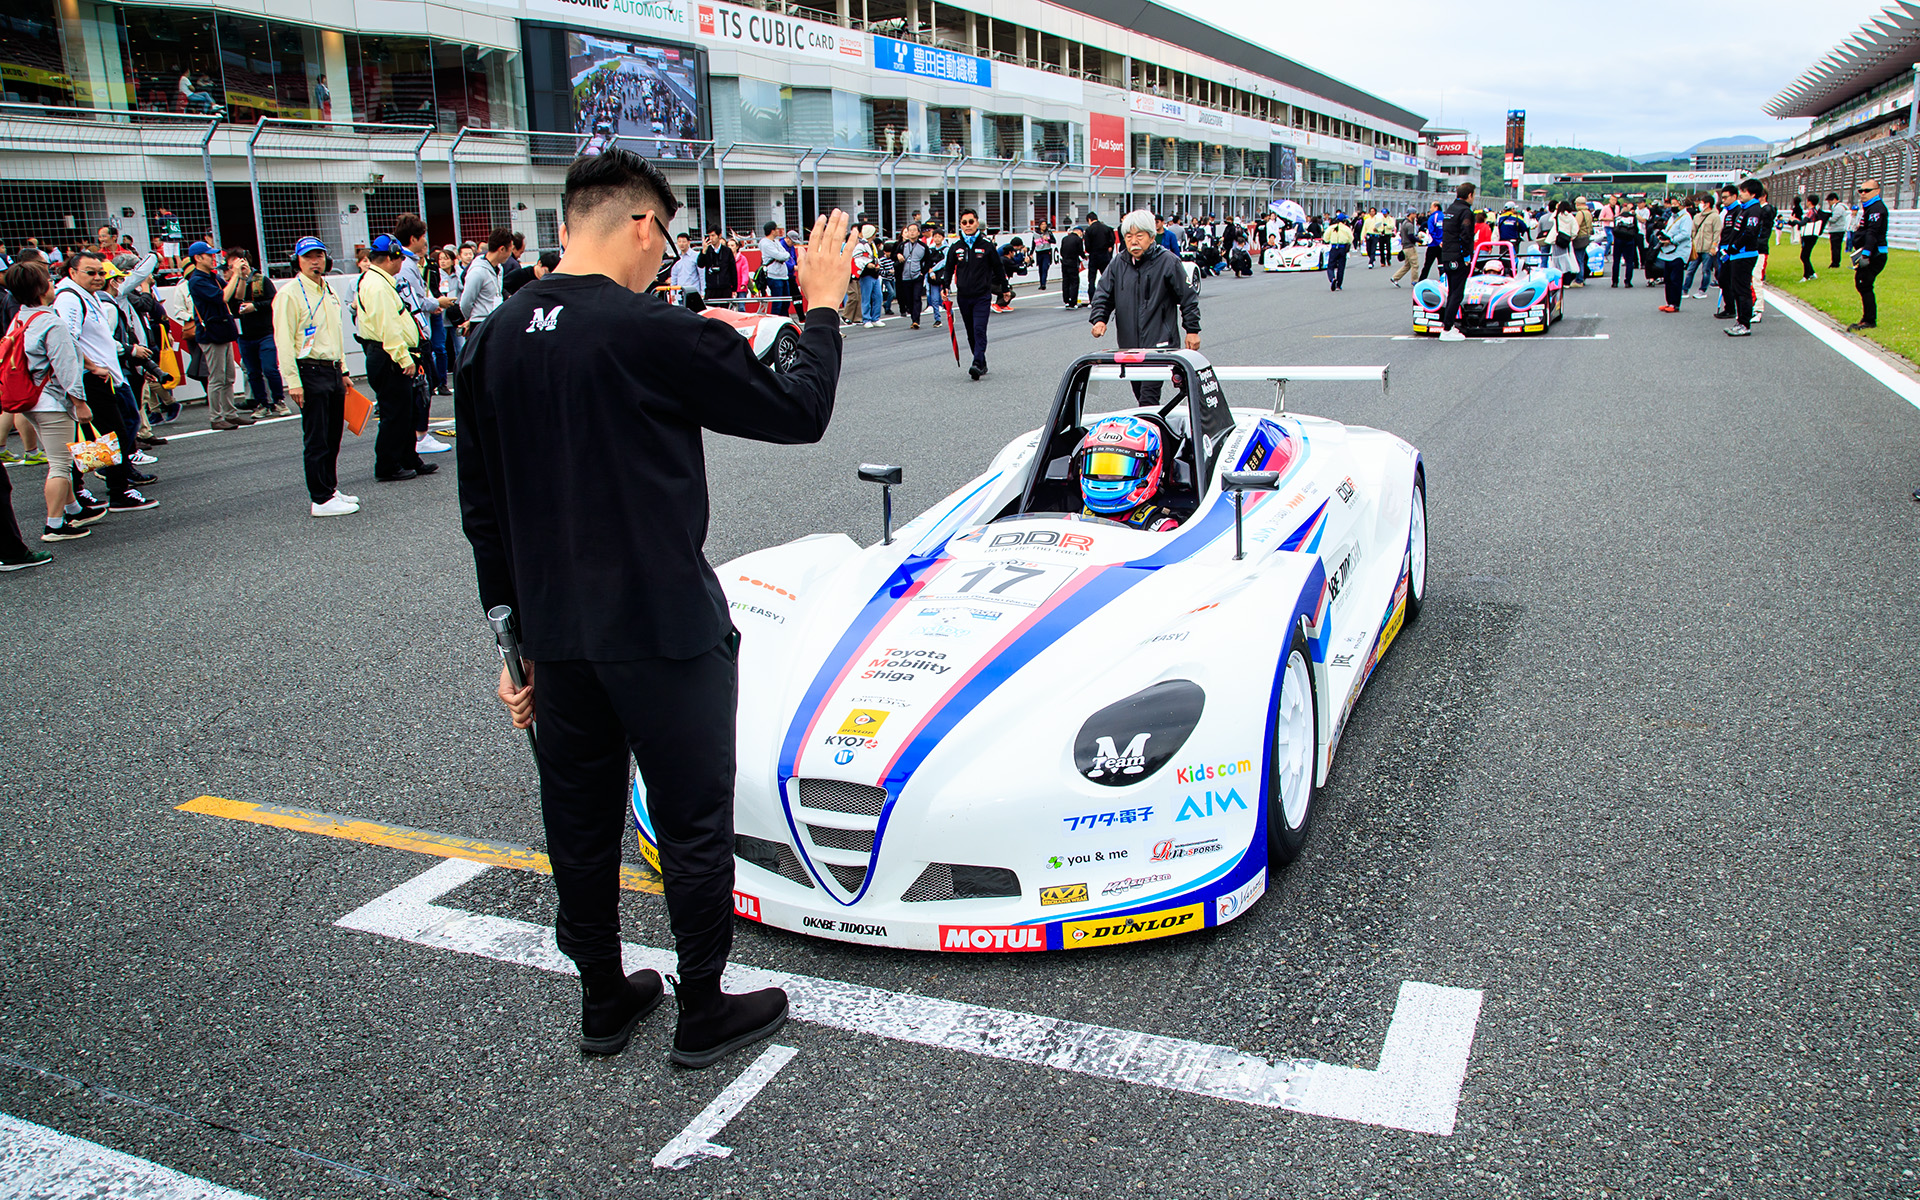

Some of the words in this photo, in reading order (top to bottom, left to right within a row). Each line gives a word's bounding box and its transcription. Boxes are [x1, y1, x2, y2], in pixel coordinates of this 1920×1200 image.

[719, 9, 742, 39] TS
[749, 15, 805, 50] CUBIC
[808, 32, 835, 50] CARD
[846, 38, 862, 49] TOYOTA
[1098, 139, 1110, 150] Audi
[1110, 140, 1124, 152] Sport
[738, 575, 796, 601] PONOS
[957, 564, 1046, 594] 17
[884, 648, 947, 660] Toyota
[861, 670, 915, 682] Shiga
[868, 659, 951, 675] Mobility
[1087, 732, 1152, 778] M
[1092, 754, 1146, 770] Team
[1177, 763, 1215, 785] Kids
[1217, 759, 1252, 777] com
[1175, 787, 1248, 822] AIM
[1063, 806, 1154, 831] フクダ電子
[1067, 854, 1091, 867] you
[1094, 851, 1105, 861] &
[1108, 849, 1128, 860] me
[802, 916, 837, 931] OKABE
[838, 921, 888, 937] JIDOSHA
[1092, 912, 1194, 938] DUNLOP
[944, 927, 1042, 949] MOTUL
